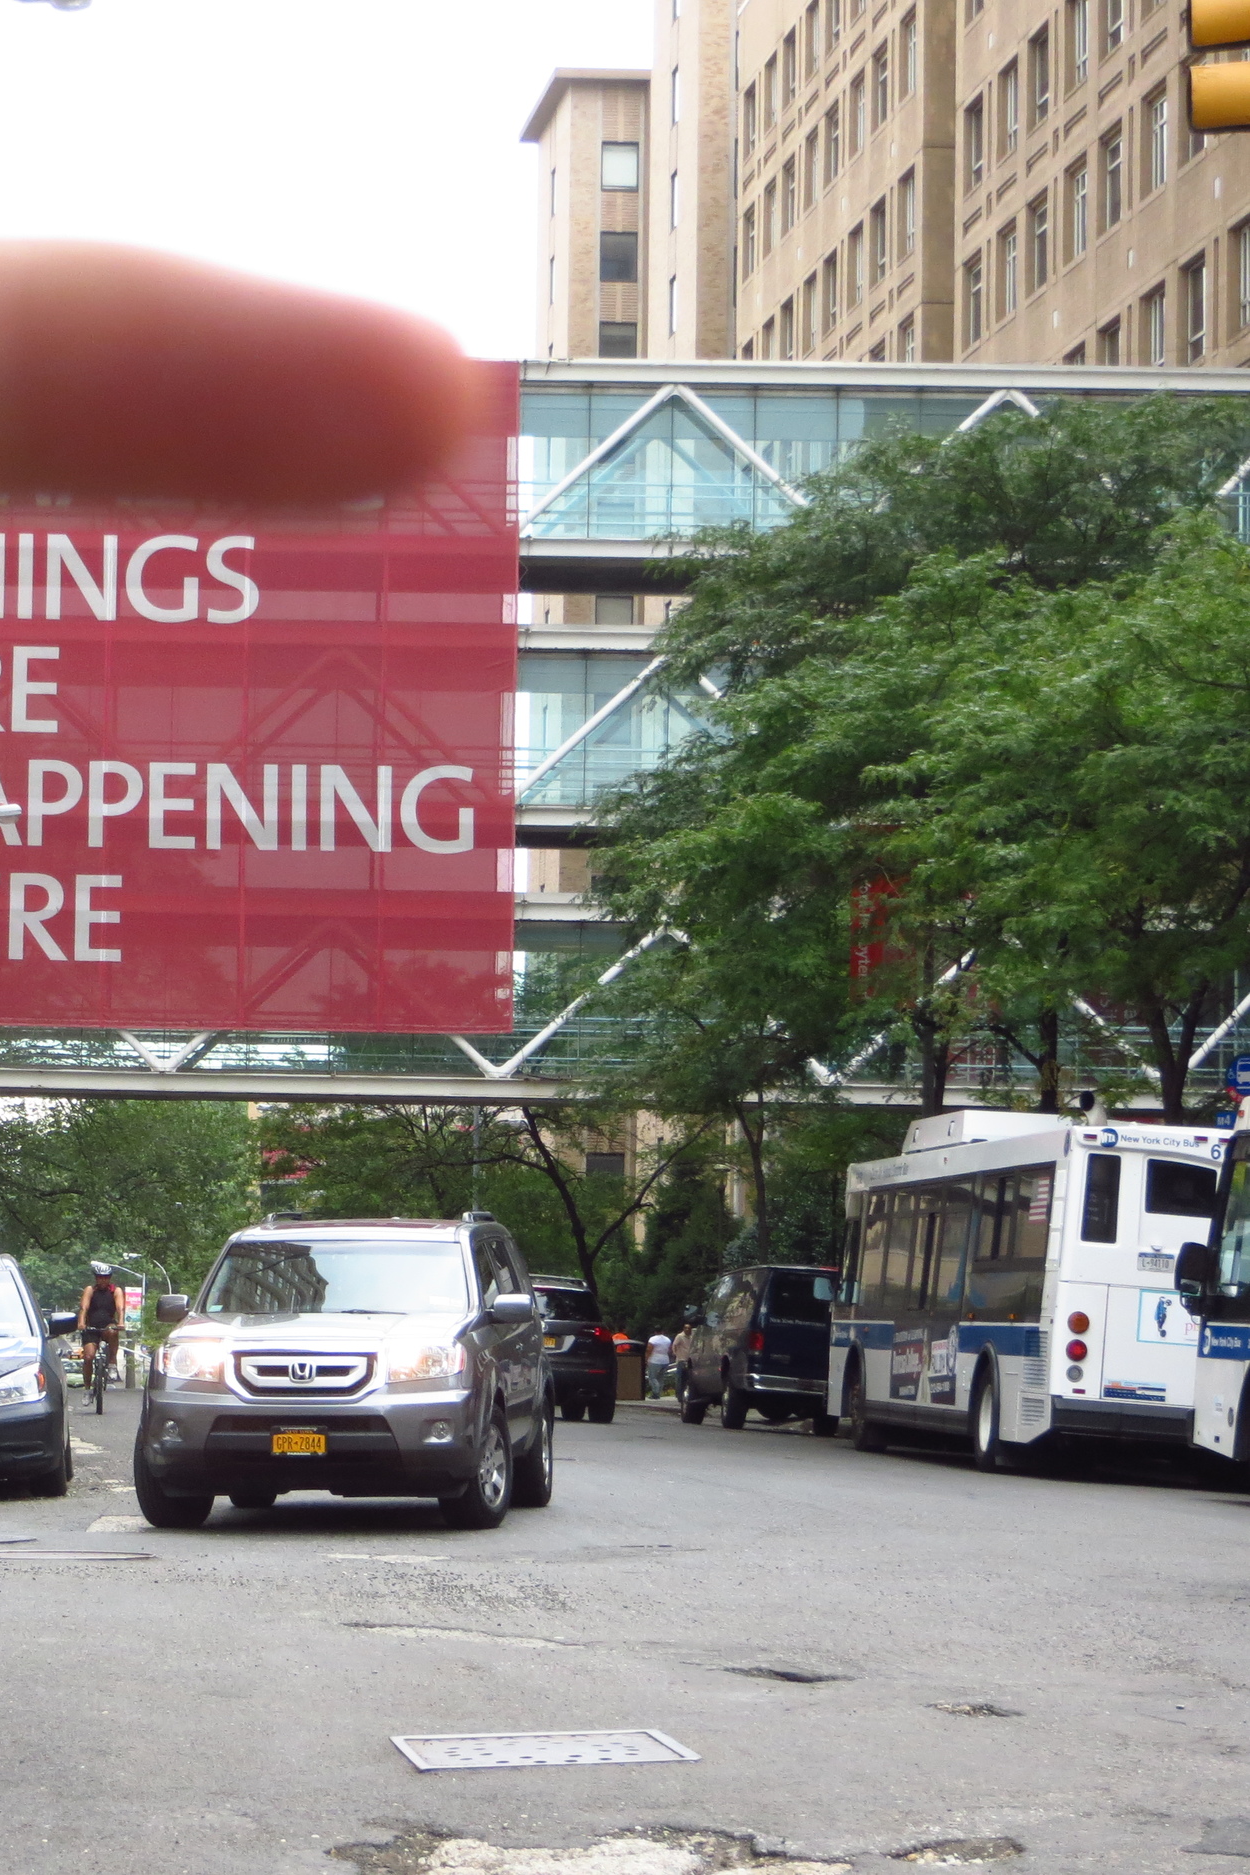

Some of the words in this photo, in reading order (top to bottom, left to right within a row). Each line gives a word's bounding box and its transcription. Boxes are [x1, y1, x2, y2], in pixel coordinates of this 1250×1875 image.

[1120, 1134, 1139, 1143] New
[1142, 1135, 1160, 1145] York
[1163, 1137, 1181, 1148] City
[1183, 1138, 1200, 1148] Bus
